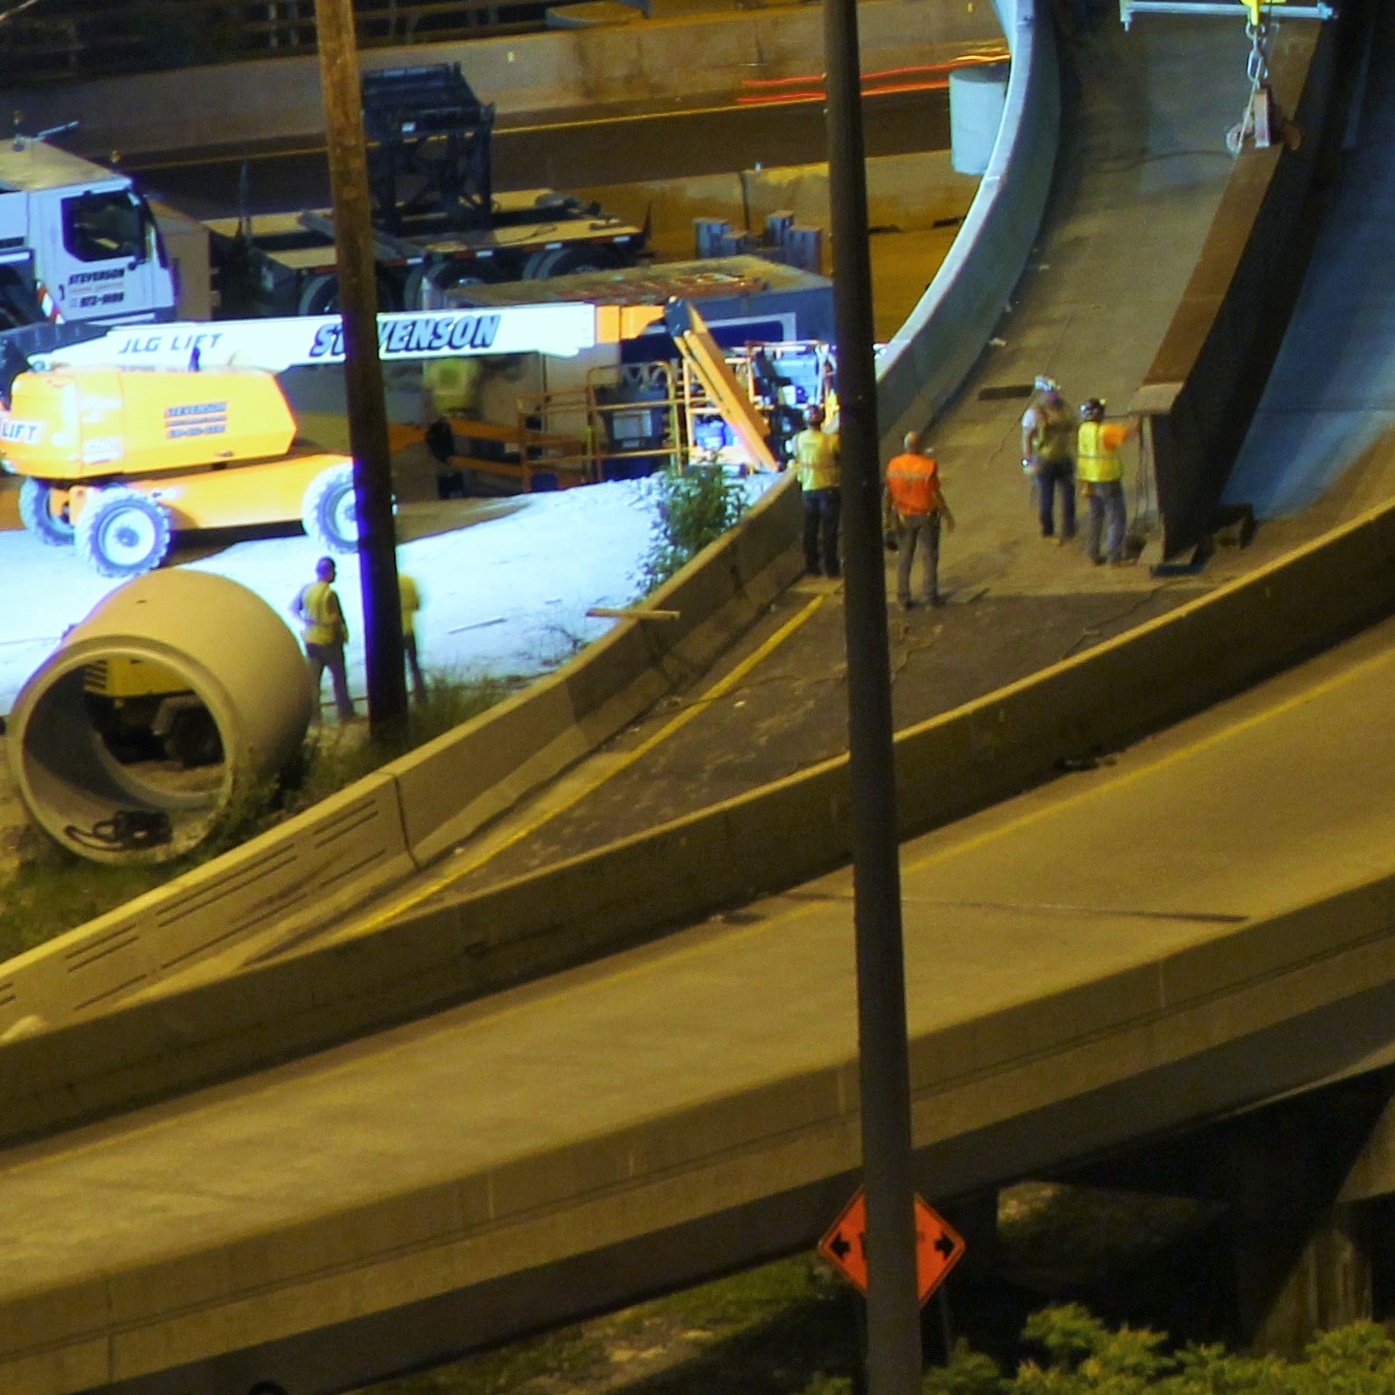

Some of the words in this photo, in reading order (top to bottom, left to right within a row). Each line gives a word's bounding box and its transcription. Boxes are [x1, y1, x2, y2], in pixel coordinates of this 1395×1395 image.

[68, 268, 125, 285] STEVENSON
[118, 337, 163, 354] JLG
[170, 333, 224, 351] LIFT
[309, 314, 501, 357] STVENSON
[1, 421, 38, 441] LIFT
